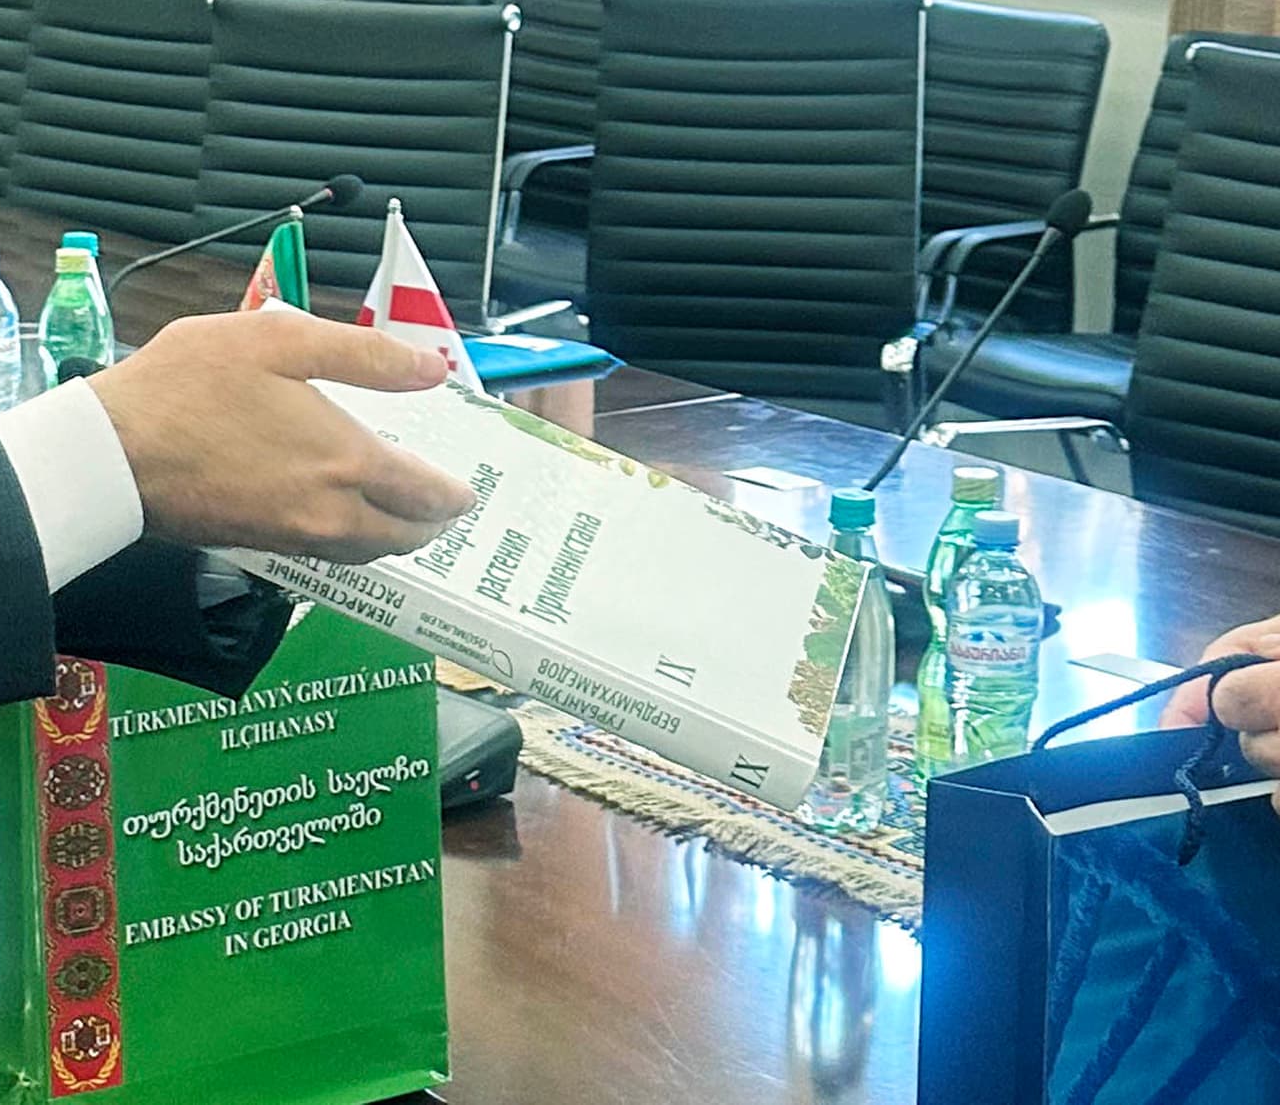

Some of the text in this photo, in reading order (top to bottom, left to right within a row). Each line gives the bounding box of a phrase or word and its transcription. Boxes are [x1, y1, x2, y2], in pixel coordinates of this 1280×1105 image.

[265, 558, 398, 628] ЛЕКАРСТВЕННЫЕ
[326, 563, 406, 609] РАСТЕНИЯ
[475, 528, 532, 606] растения
[520, 512, 601, 624] Туркменистана
[296, 661, 434, 704] GRUZIÝADAKY
[528, 678, 626, 731] ГУРБАНГУЛЫ
[538, 658, 681, 734] БЕРДЫМУХАМЕДОВ
[221, 708, 338, 750] ILÇIHANASY
[122, 755, 430, 838] თურქმენეთის საელჩო
[177, 802, 382, 869] საქართველოში
[125, 859, 435, 945] EMBASSY OF TURKMENISTAN
[225, 910, 352, 956] IN GEORGIA
